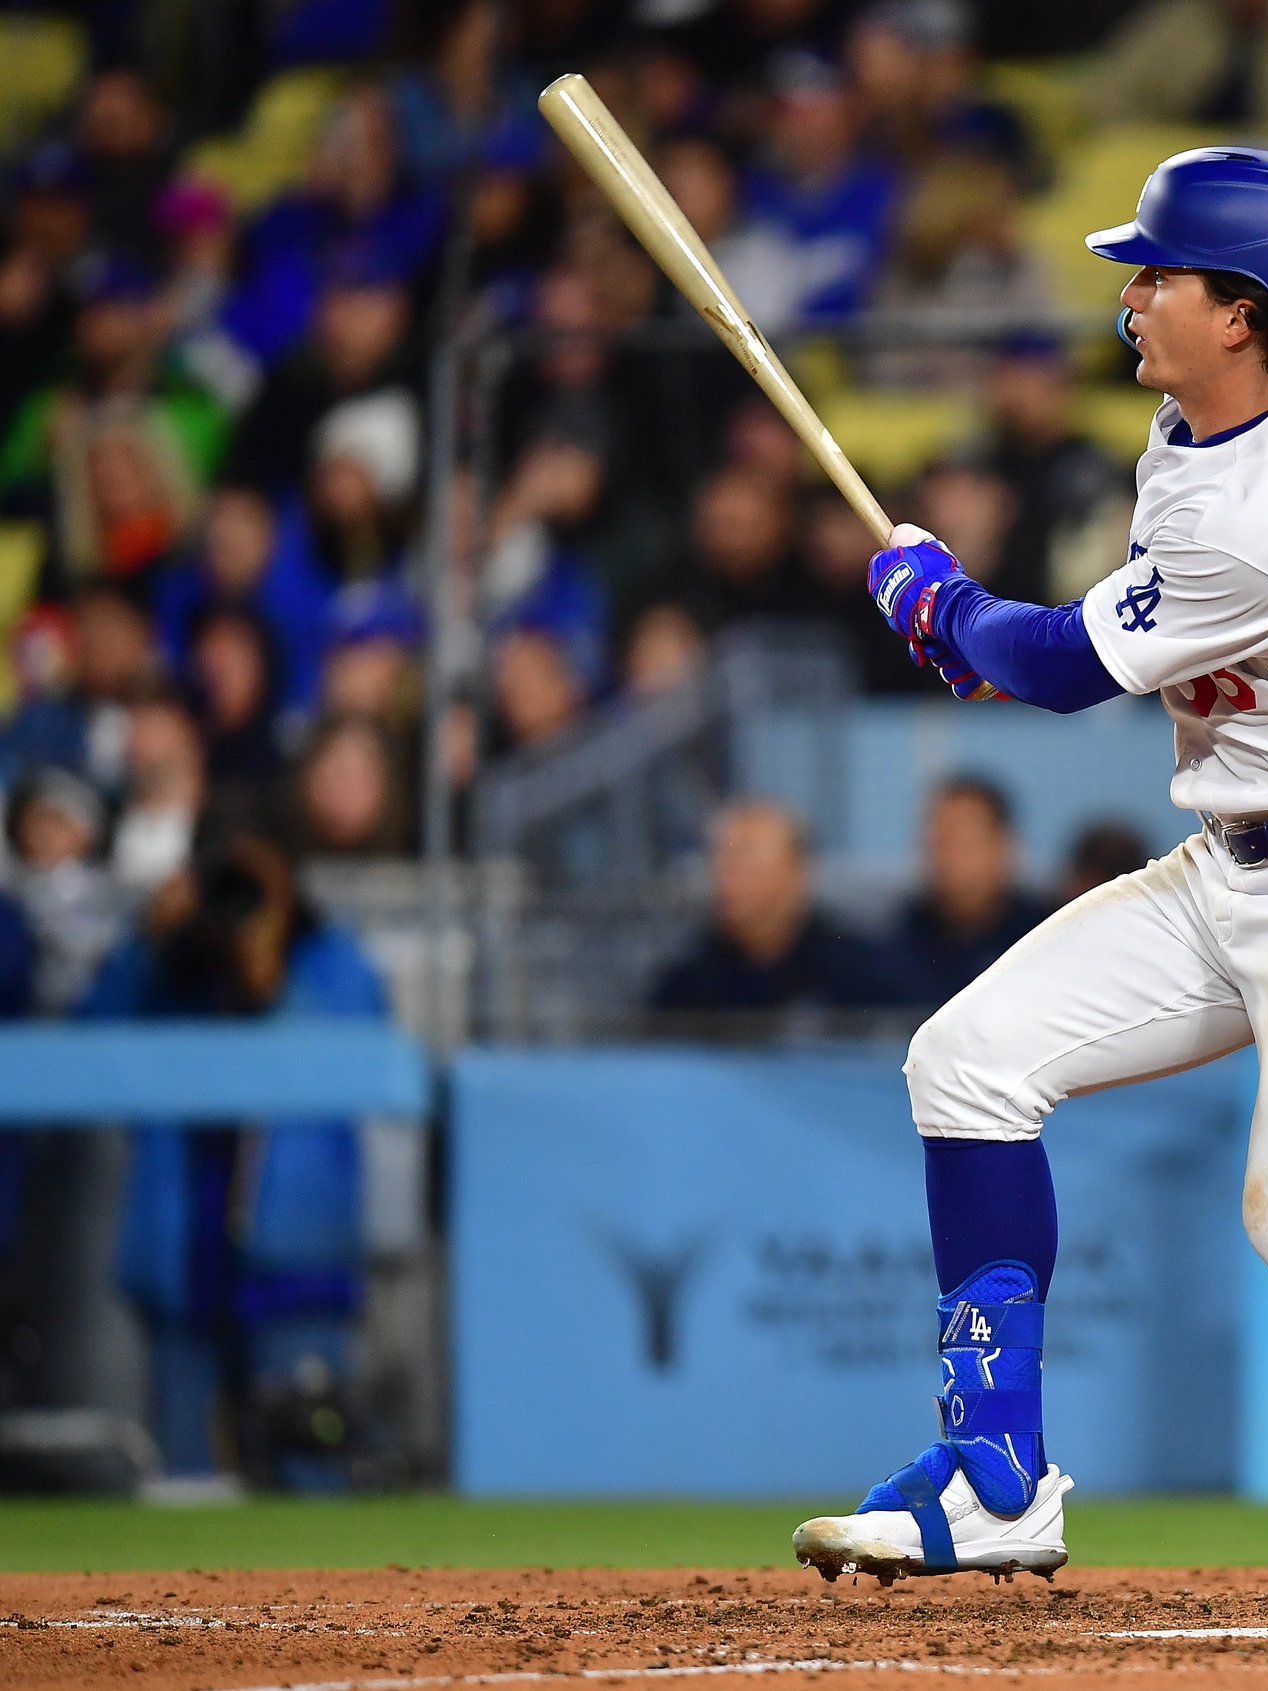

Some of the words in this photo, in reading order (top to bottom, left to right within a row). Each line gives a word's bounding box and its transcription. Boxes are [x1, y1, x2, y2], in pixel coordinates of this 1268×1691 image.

[880, 567, 911, 608] Franklin
[1115, 565, 1165, 633] LA
[969, 1307, 992, 1342] LA
